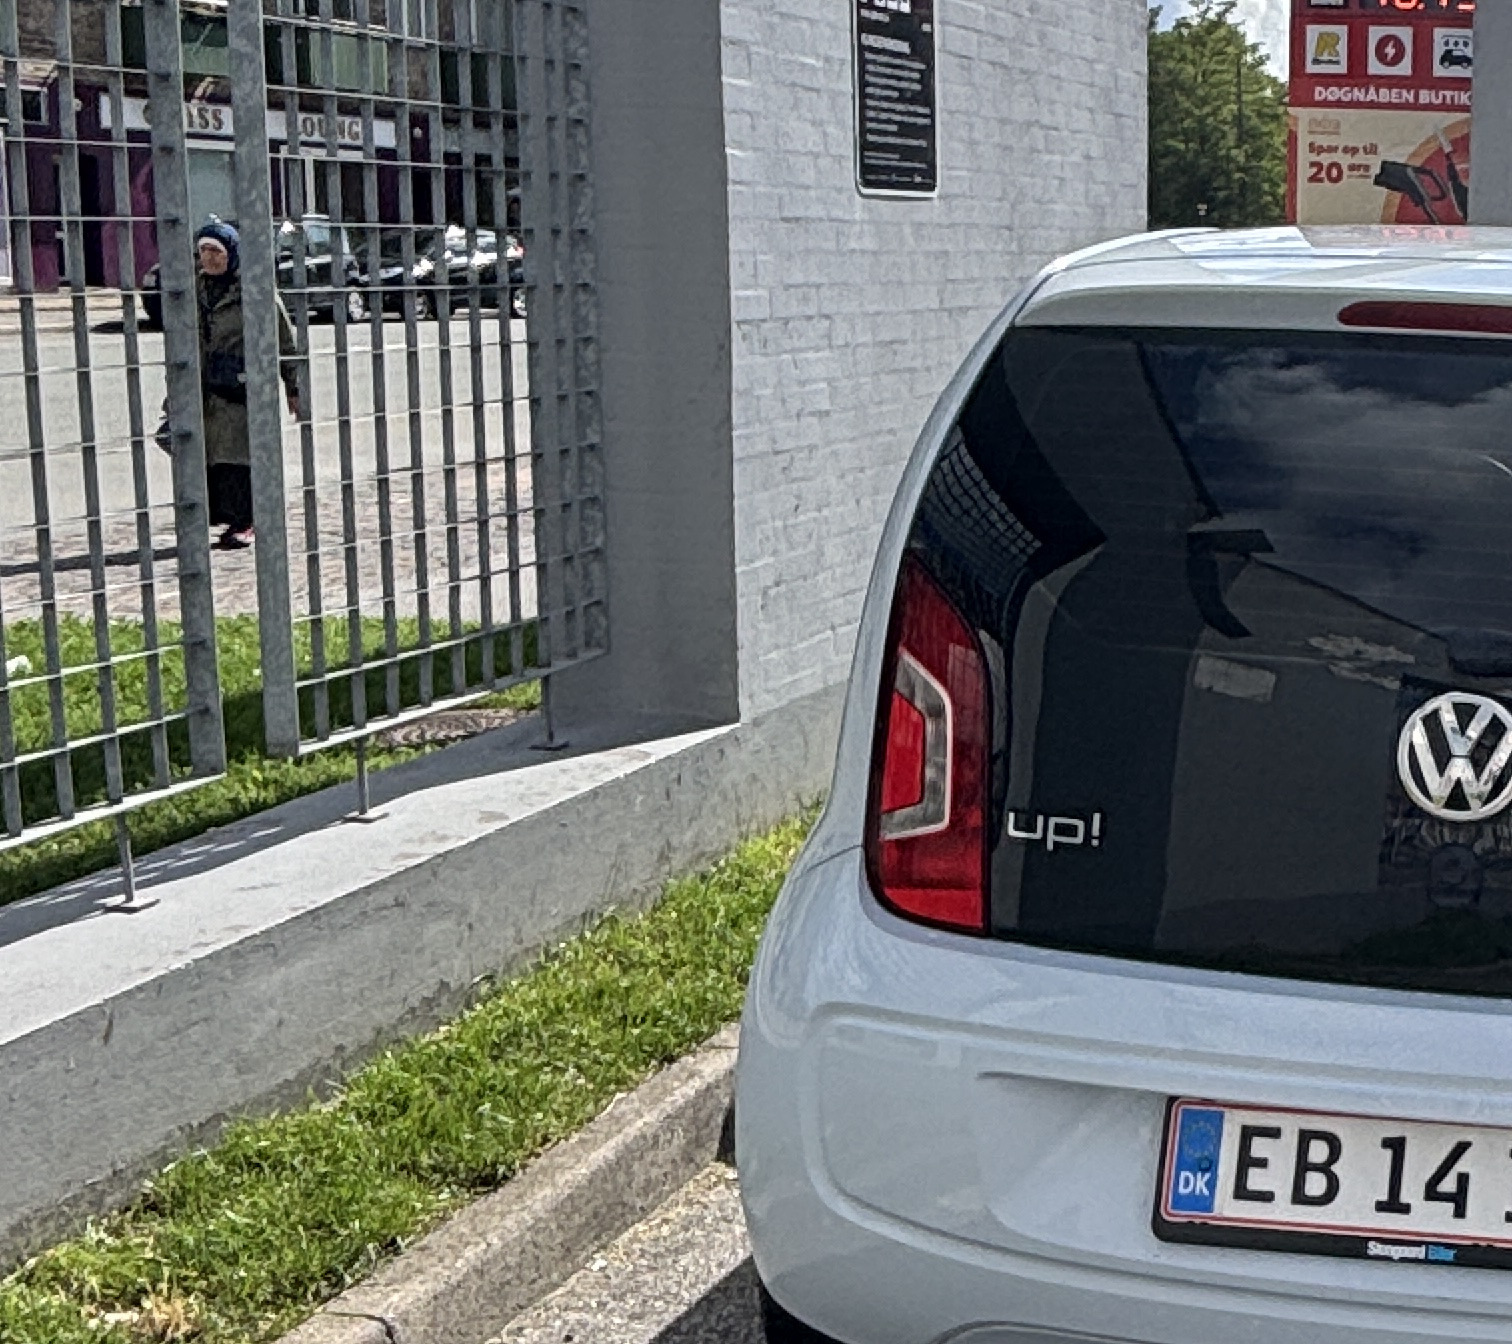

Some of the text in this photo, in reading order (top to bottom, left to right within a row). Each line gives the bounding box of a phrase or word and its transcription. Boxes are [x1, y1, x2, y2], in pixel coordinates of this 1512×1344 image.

[1314, 85, 1472, 106] DØGNÅBEN BUTIK
[1308, 141, 1379, 158] Spar op til
[1307, 160, 1344, 184] 20
[1007, 811, 1102, 852] up!
[1177, 1170, 1210, 1197] DK
[1231, 1124, 1343, 1207] EB
[1373, 1135, 1473, 1220] 14
